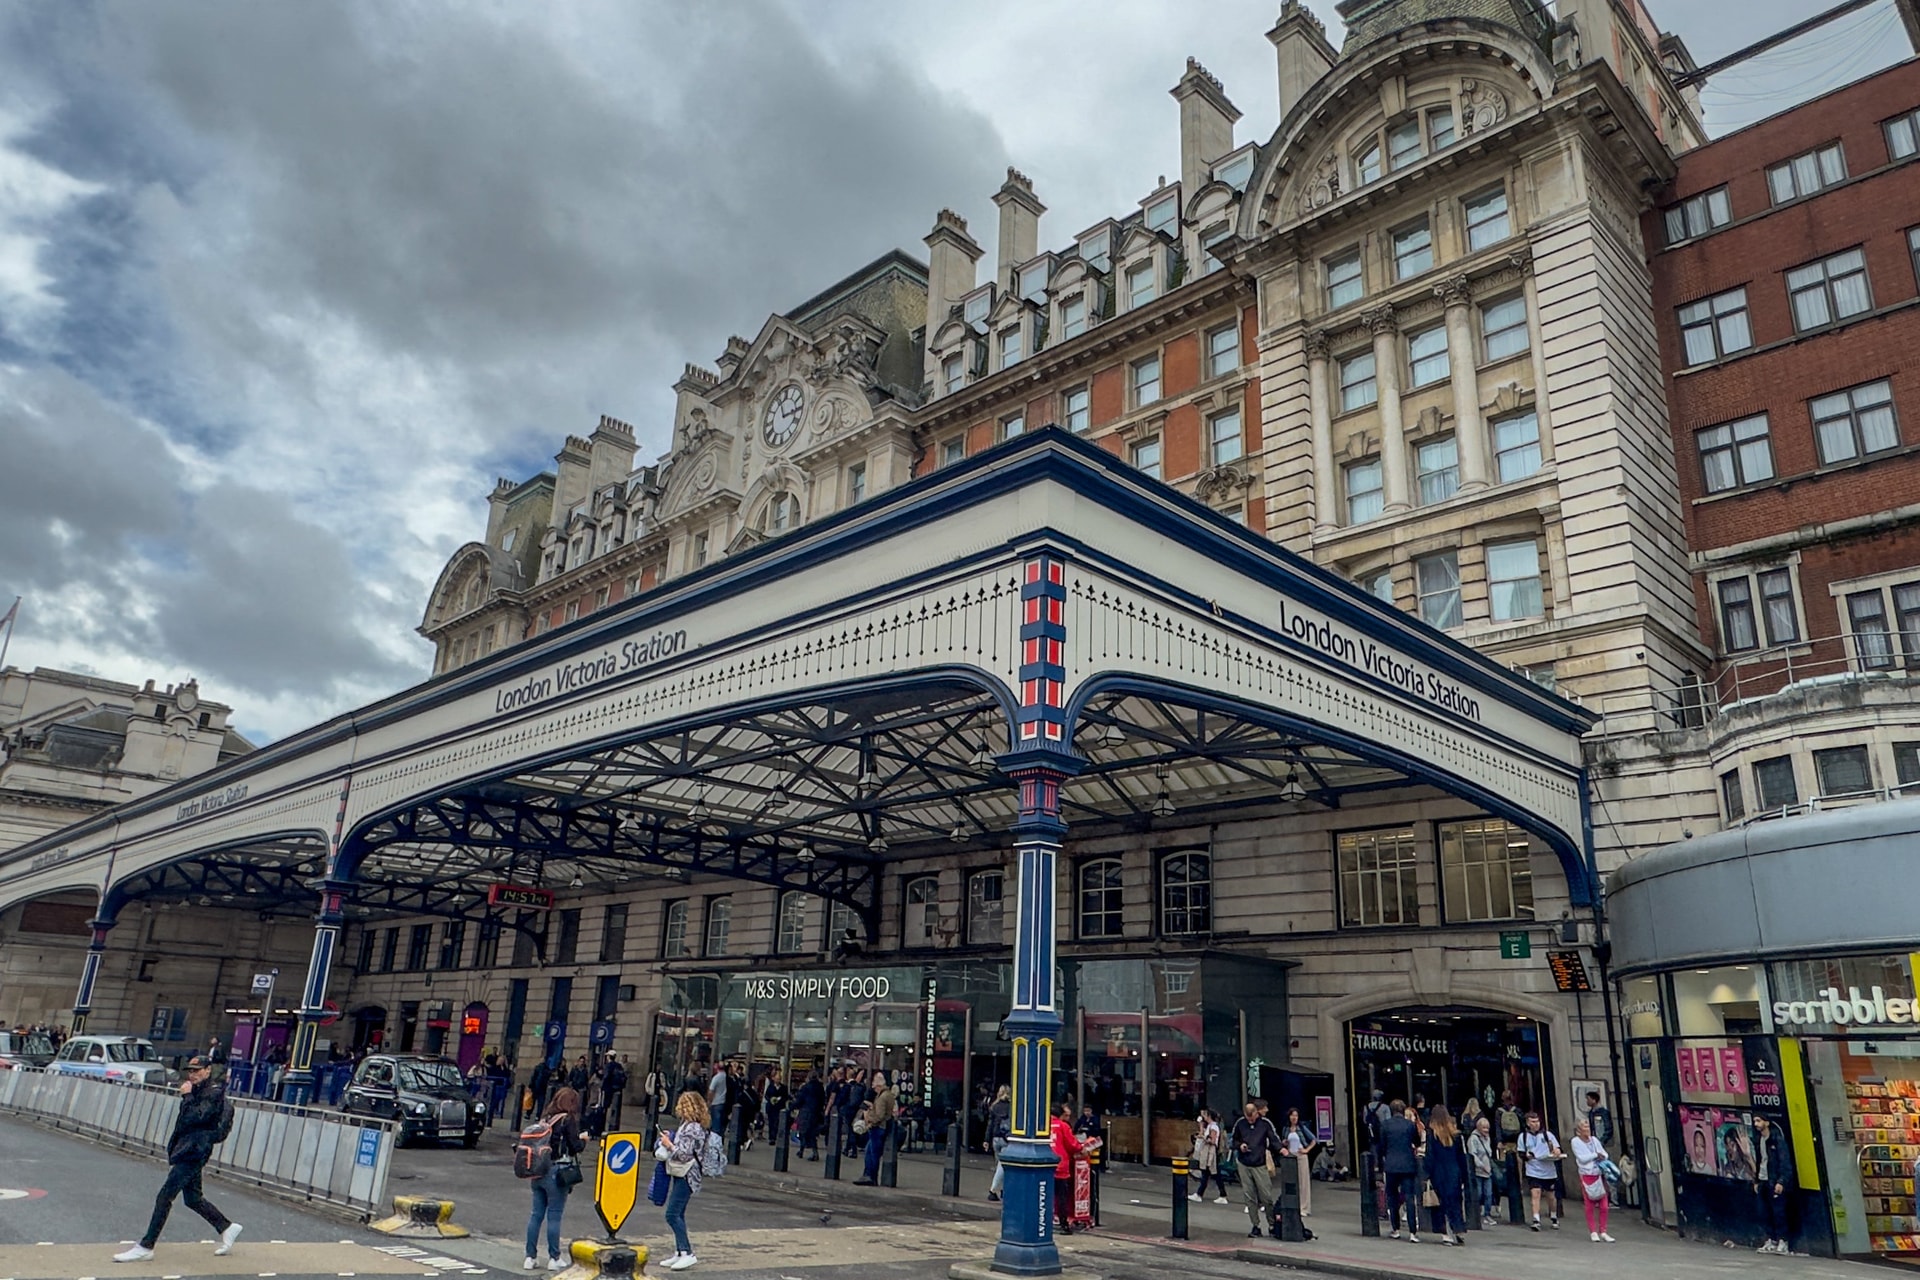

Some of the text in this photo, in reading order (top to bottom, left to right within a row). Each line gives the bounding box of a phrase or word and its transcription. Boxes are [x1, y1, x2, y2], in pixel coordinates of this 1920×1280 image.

[495, 630, 687, 713] London Victoria Station
[1280, 600, 1481, 721] London Victoria Station
[1510, 944, 1520, 956] E
[745, 976, 890, 999] M&S SIMPLY FOOD
[923, 979, 936, 1108] STARBUCKS COFFEE
[1752, 1083, 1779, 1094] save
[1753, 1095, 1781, 1106] more
